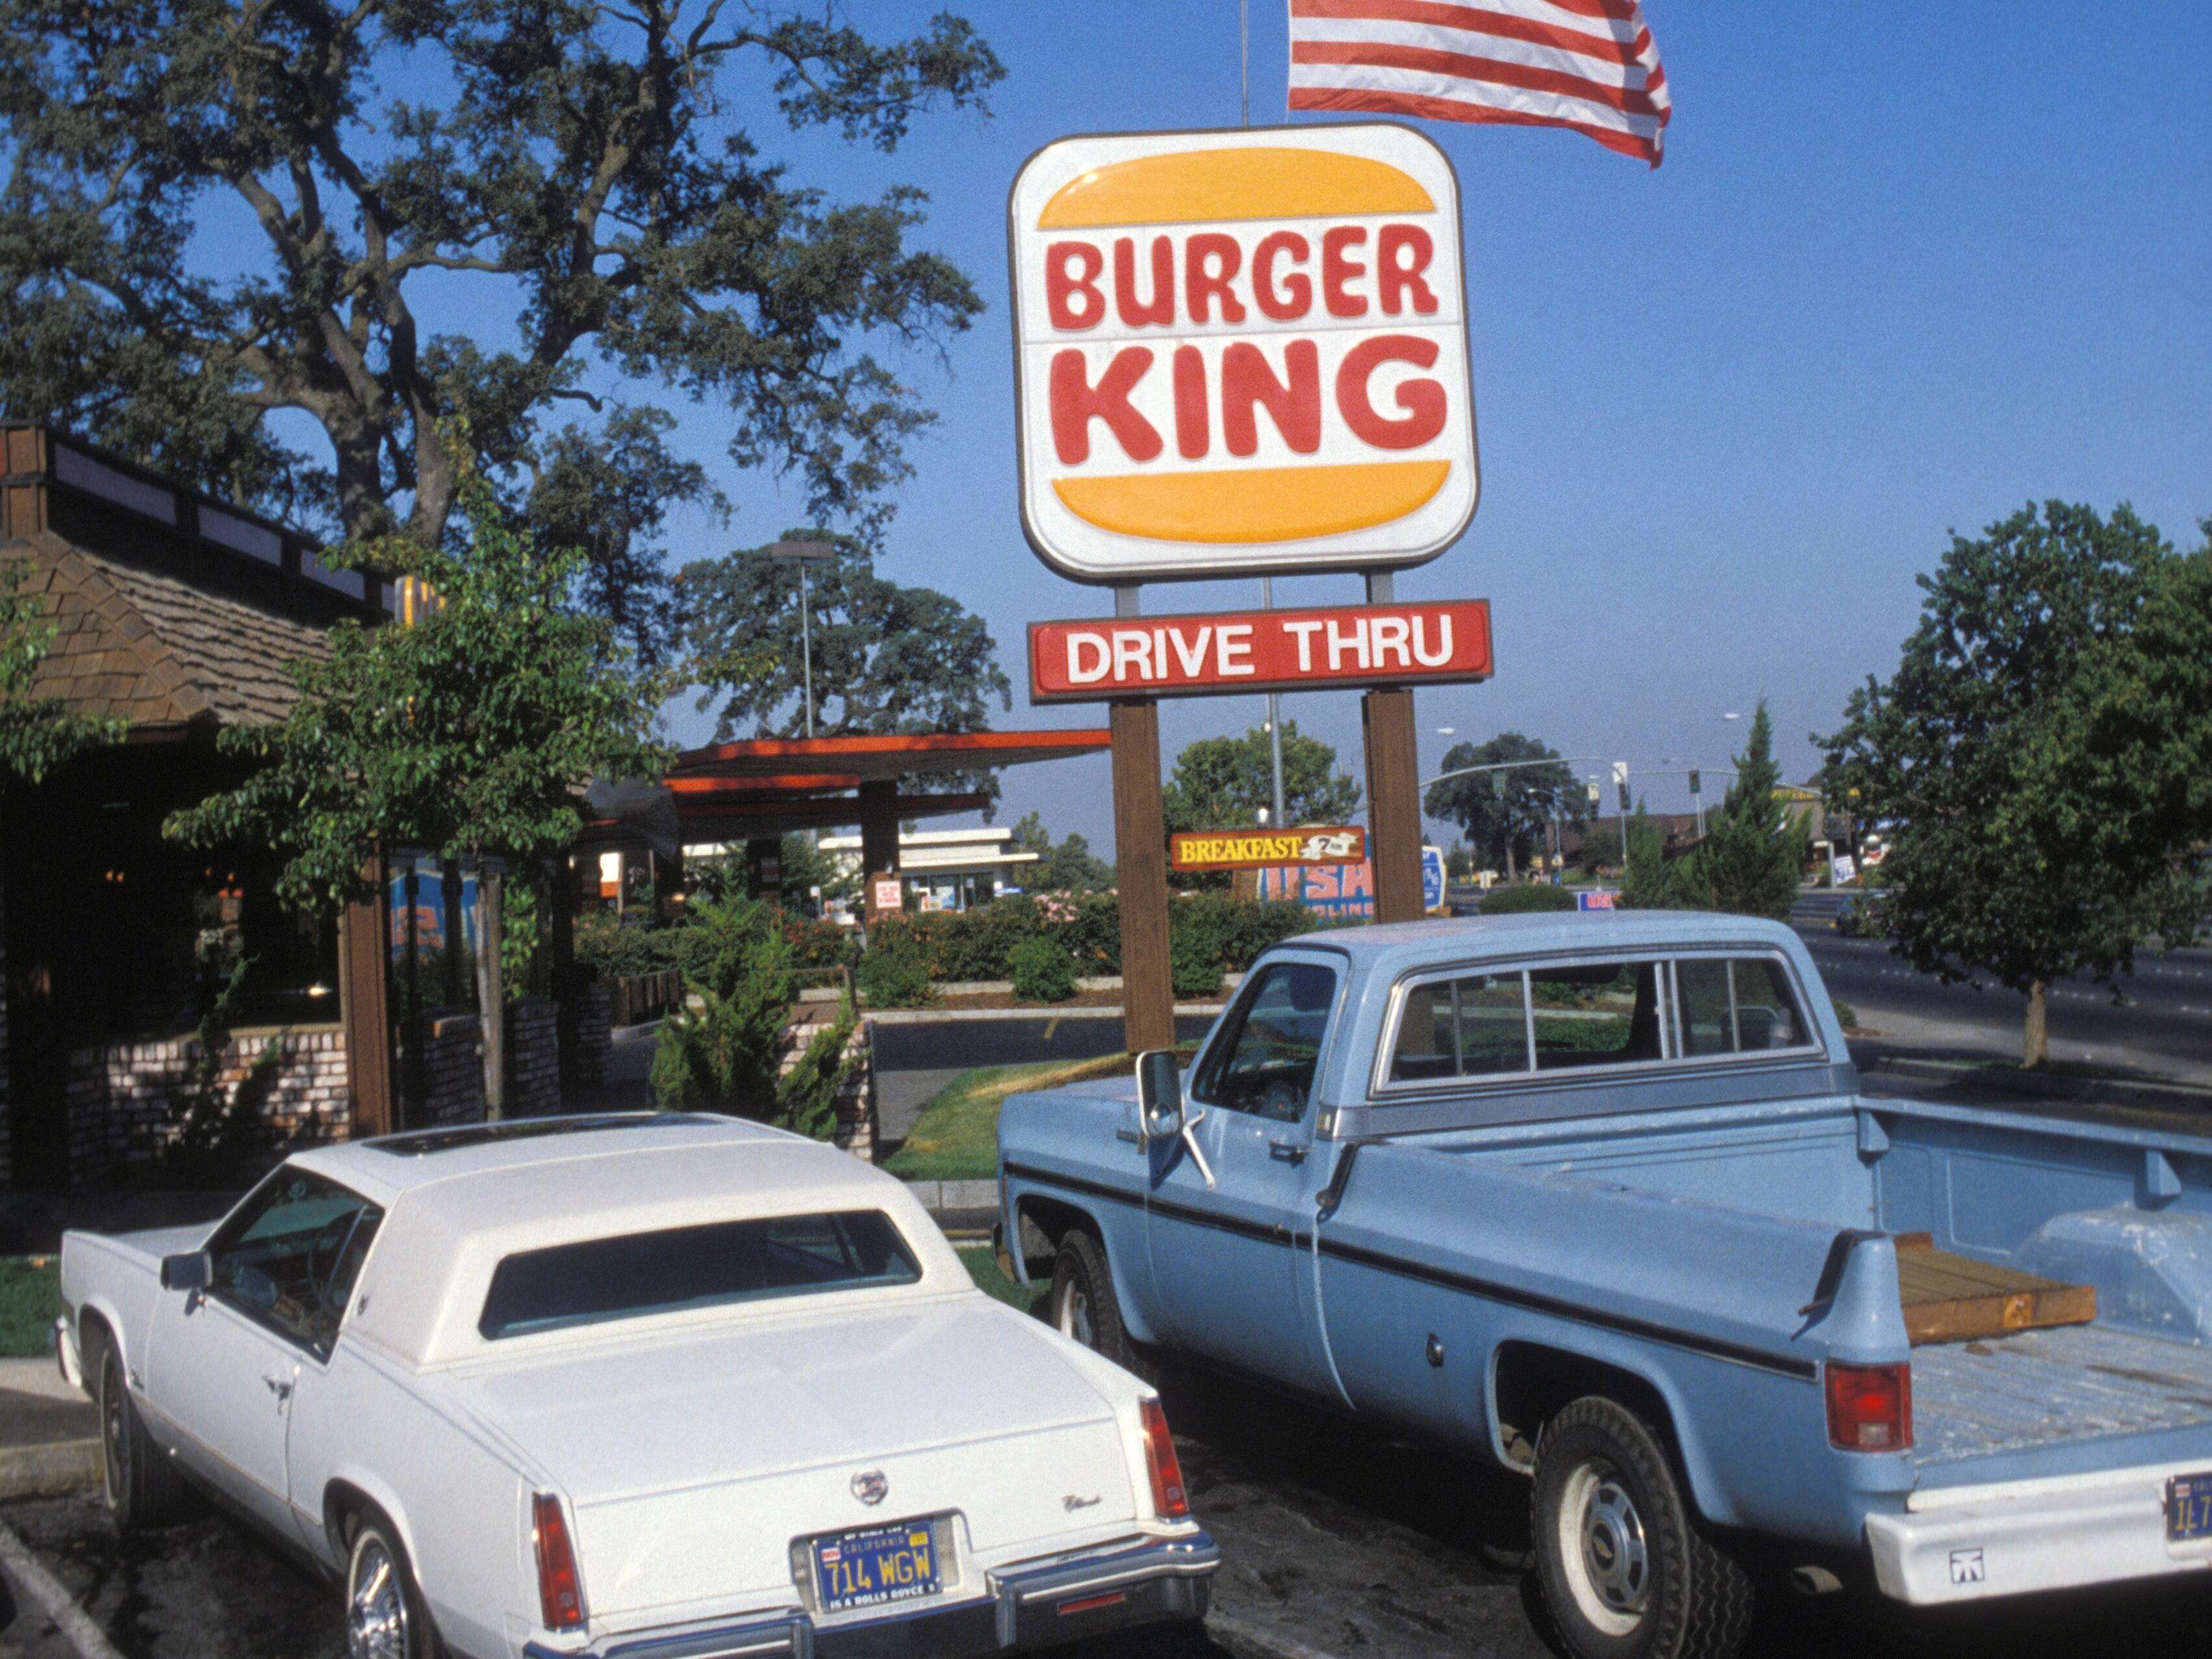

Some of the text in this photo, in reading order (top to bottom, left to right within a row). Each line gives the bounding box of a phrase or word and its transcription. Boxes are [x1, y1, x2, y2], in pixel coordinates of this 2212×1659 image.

[1045, 224, 1438, 331] BURGER
[1050, 335, 1447, 465] KING
[1066, 615, 1453, 684] DRIVE THRU
[1180, 836, 1303, 864] BREAKFAST
[1267, 859, 1373, 902] USA
[845, 1536, 905, 1554] CALIFORNIA
[824, 1547, 930, 1595] 714 WGW
